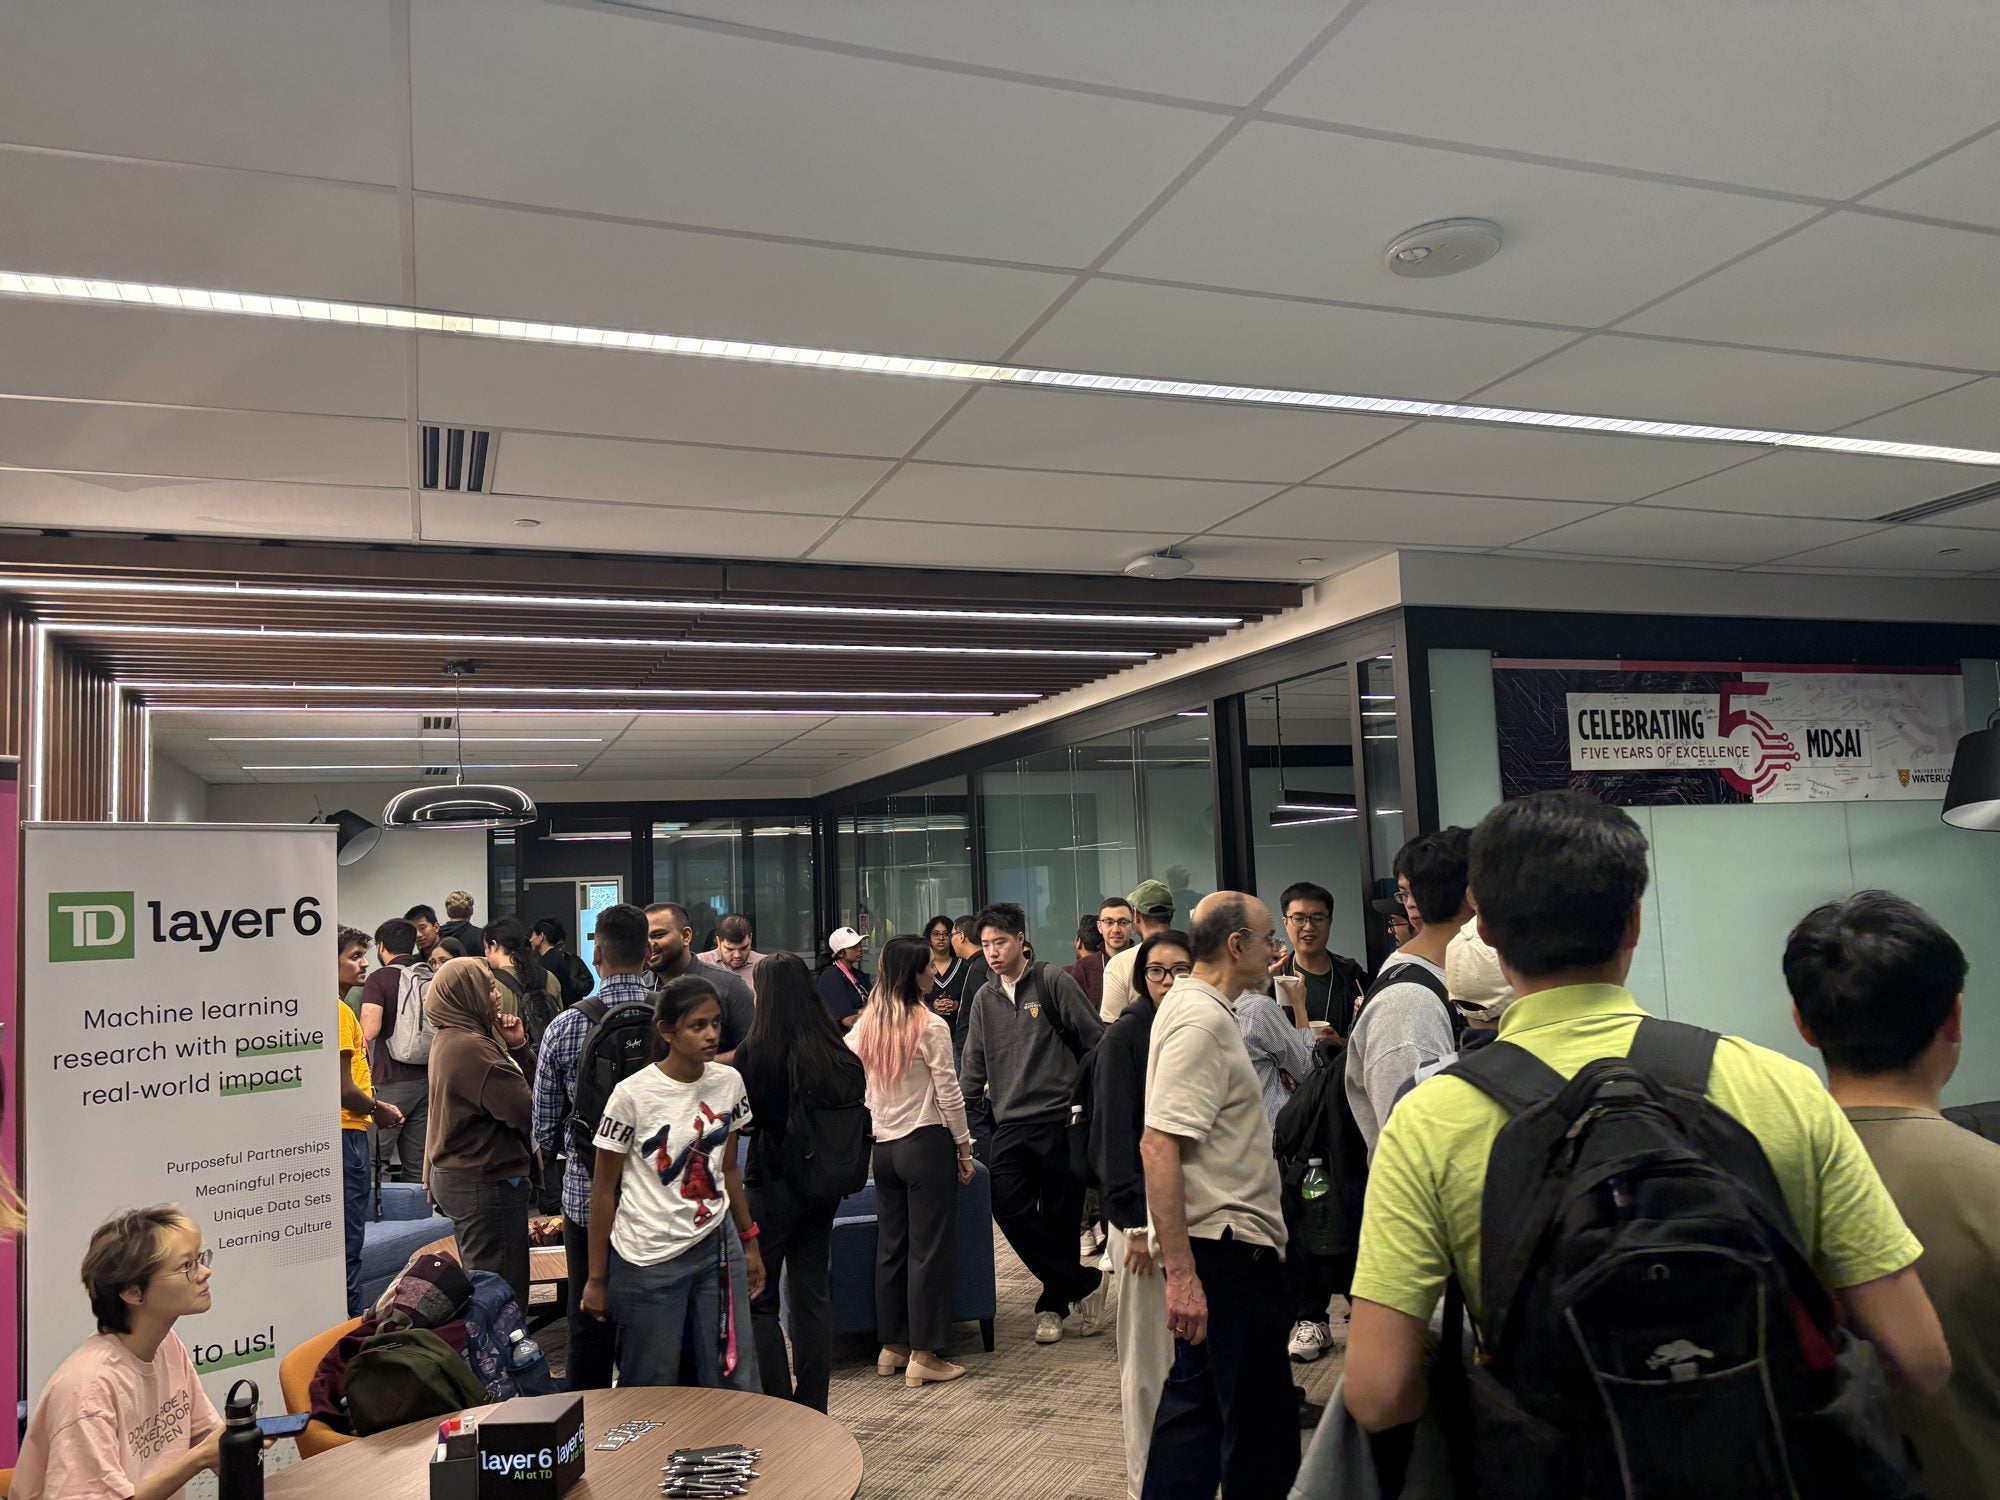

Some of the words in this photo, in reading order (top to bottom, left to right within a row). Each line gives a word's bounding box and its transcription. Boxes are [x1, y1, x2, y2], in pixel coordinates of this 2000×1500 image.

[1578, 709, 1704, 740] CELEBRATING
[1581, 747, 1610, 760] FIVE
[1613, 747, 1653, 759] YEARS
[1657, 746, 1673, 759] OF
[1677, 746, 1750, 758] EXCELLENCE
[1806, 728, 1862, 758] MDSAI
[1912, 774, 1951, 783] WATERLO
[58, 905, 126, 947] TD
[147, 900, 286, 952] layer
[293, 896, 322, 936] 6
[84, 1005, 193, 1029] Machine
[202, 997, 298, 1020] learning
[53, 1041, 166, 1070] research
[176, 1035, 226, 1058] with
[235, 1028, 324, 1056] positive
[82, 1073, 210, 1106] real-world
[219, 1065, 302, 1091] impact
[167, 1151, 243, 1174] Purposeful
[247, 1140, 330, 1162] Partnerships
[196, 1174, 274, 1197] Meaningful
[279, 1166, 331, 1184] Projects
[214, 1204, 263, 1222] Unique
[268, 1199, 300, 1213] Data
[304, 1193, 331, 1207] Sets
[219, 1229, 280, 1249] Learning
[285, 1219, 332, 1238] Culture
[193, 1344, 223, 1366] to
[234, 1325, 275, 1356] us!
[182, 1390, 189, 1402] A
[139, 1445, 151, 1462] TO
[557, 1431, 579, 1465] layer
[579, 1422, 584, 1443] 6
[480, 1451, 537, 1475] layer
[539, 1448, 553, 1468] 6
[514, 1470, 524, 1480] AI
[527, 1471, 537, 1480] at
[539, 1469, 553, 1480] TD
